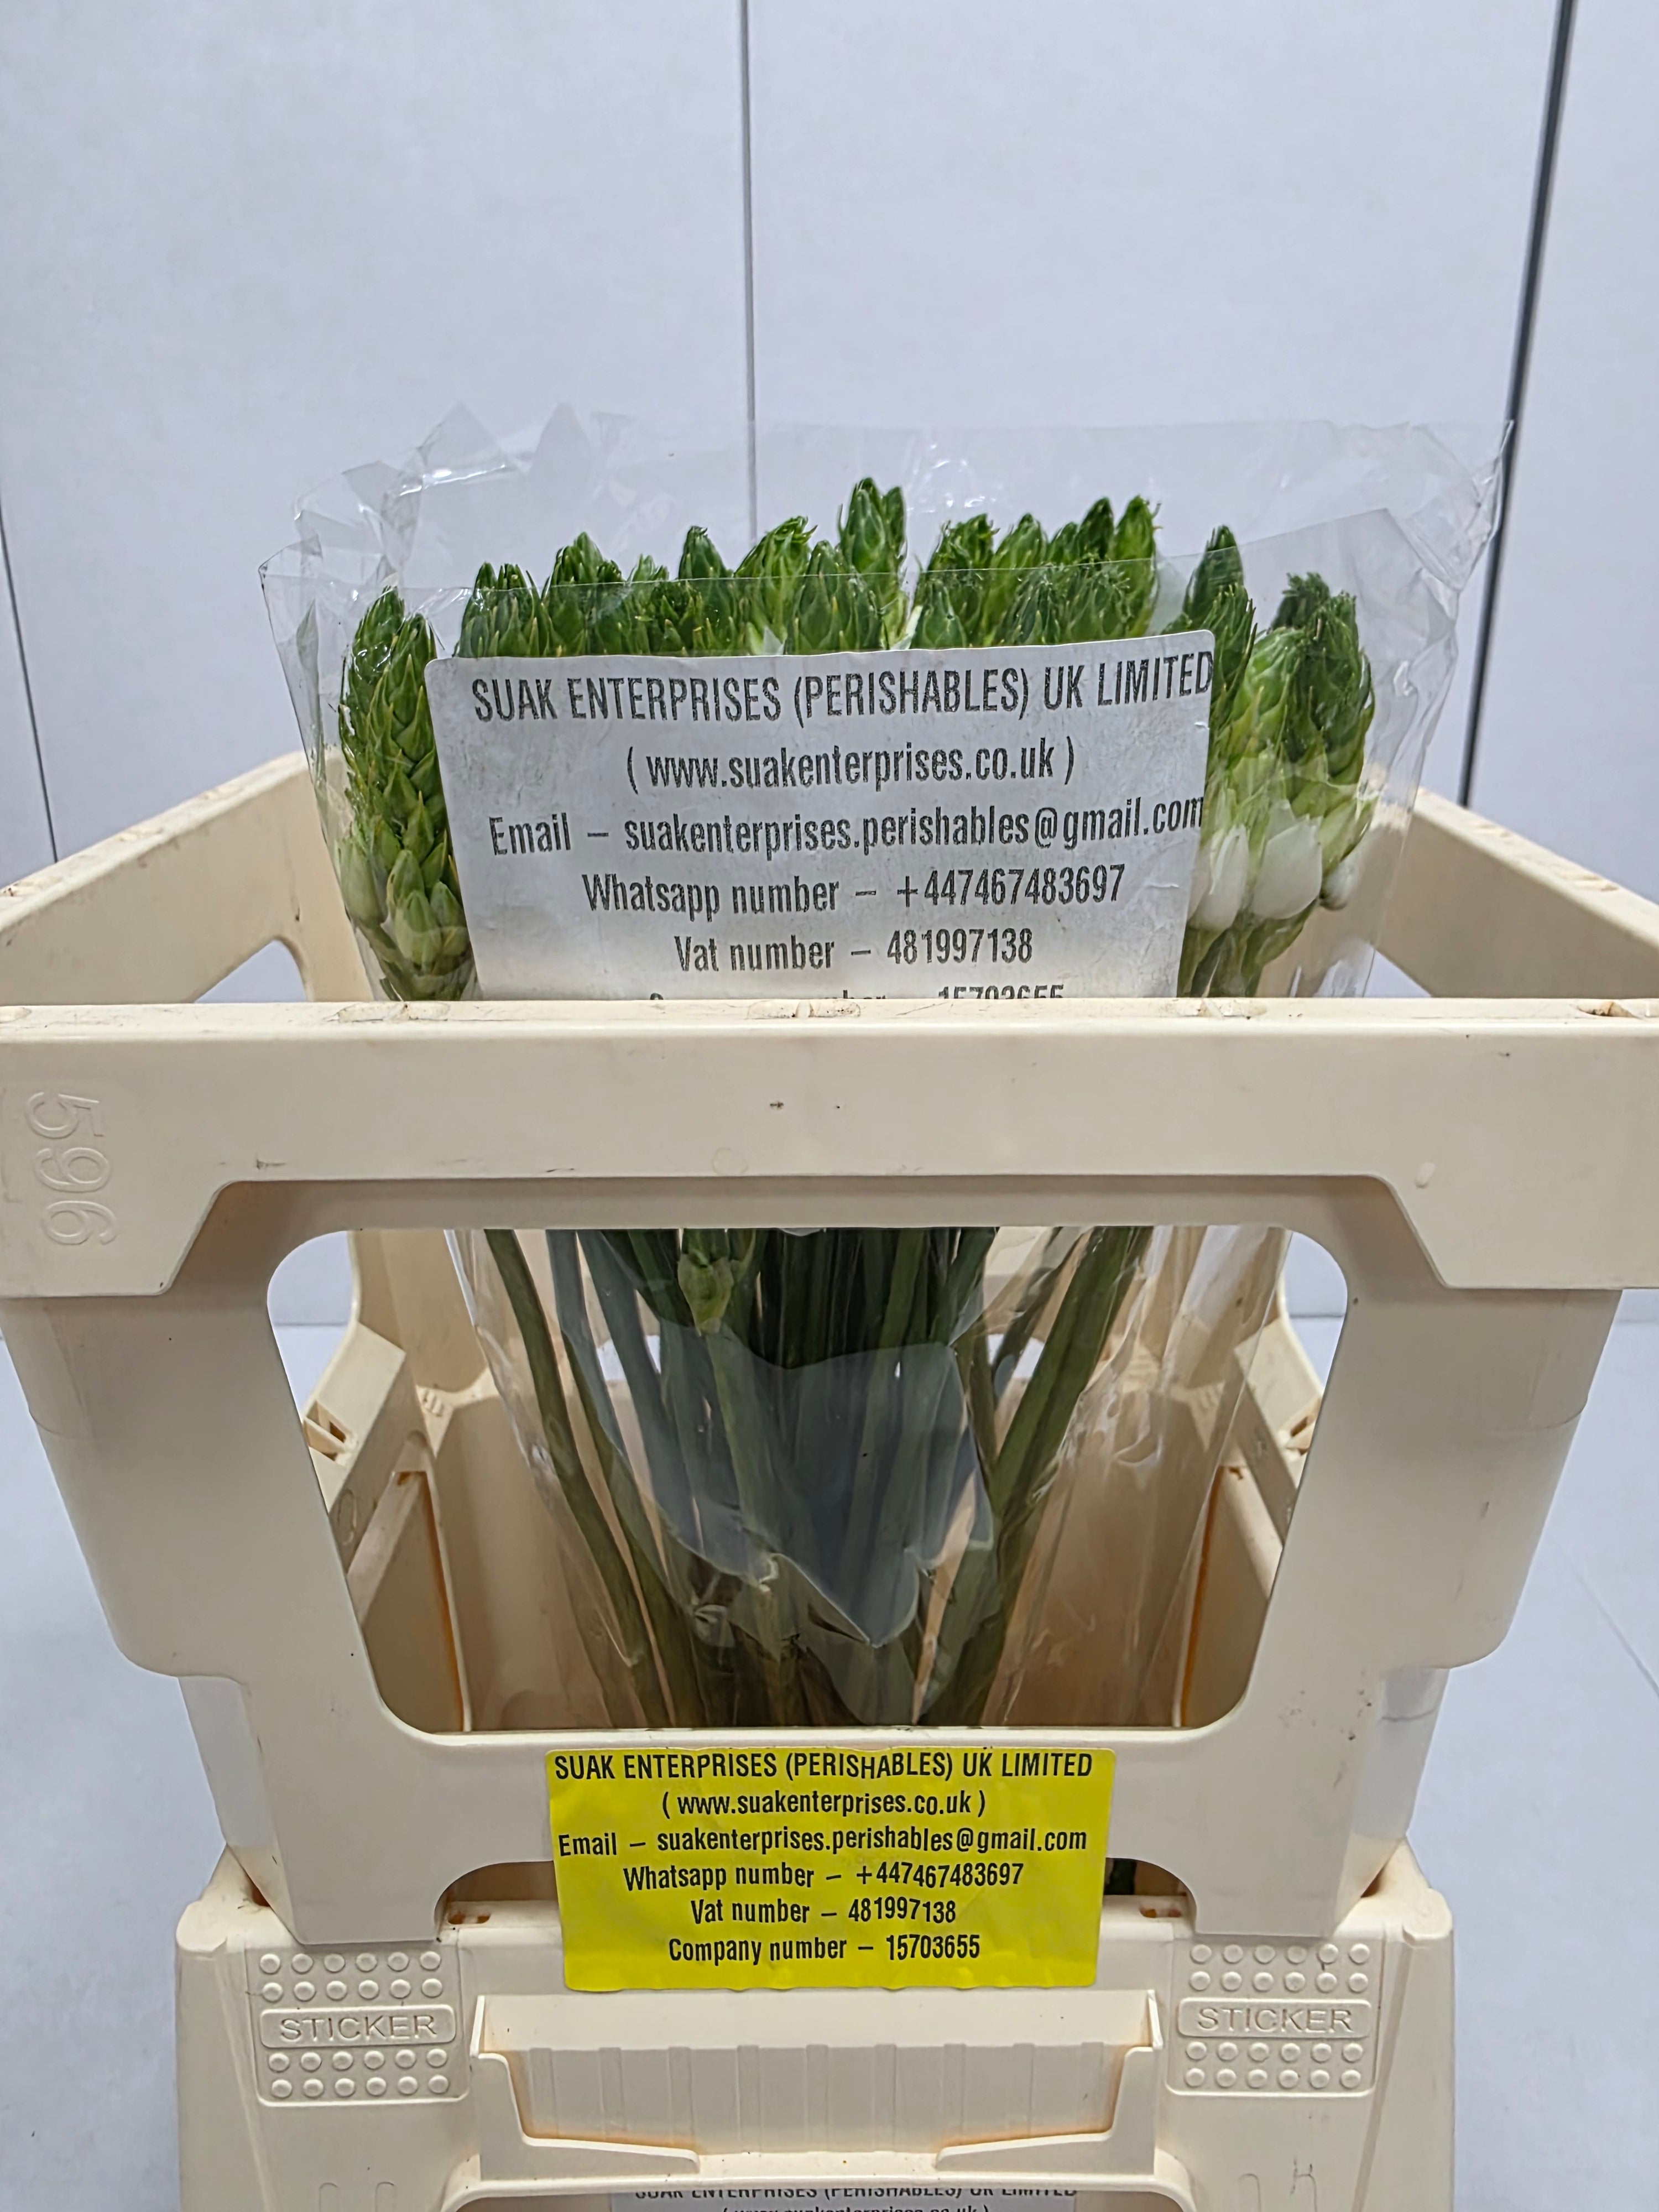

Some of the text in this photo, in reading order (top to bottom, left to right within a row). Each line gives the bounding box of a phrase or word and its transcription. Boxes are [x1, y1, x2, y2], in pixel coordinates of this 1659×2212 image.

[472, 651, 1213, 728] SUAK ENTERPRISES (PERISHABLES) UK LIMITED
[646, 737, 1055, 792] www.suakenterprises.co.uk
[489, 812, 571, 855] Email
[582, 873, 721, 922] Whatsapp
[732, 876, 840, 915] number
[896, 864, 1125, 909] +447467483697
[674, 935, 719, 972] Vat
[730, 934, 835, 971] number
[886, 928, 1032, 965] 481997138
[25, 1091, 117, 1245] 596
[555, 1751, 1092, 1782] SUAK ENTERPRISES (PERISHABLES) UK LIMITED
[677, 1790, 972, 1816] www.suakenterprises.co.uk
[559, 1832, 617, 1857] Email
[657, 1825, 1087, 1855] suakenterprises.perishables@gmail.com
[623, 1865, 727, 1892] Whatsapp
[735, 1863, 814, 1887] number
[857, 1861, 1024, 1888] +447467483697
[691, 1900, 724, 1924] Vat
[732, 1898, 810, 1923] number
[849, 1896, 956, 1924] 481997138
[669, 1938, 762, 1966] Company
[769, 1936, 847, 1960] number
[886, 1933, 980, 1961] 15703655
[280, 2014, 437, 2041] STICKER
[1197, 2007, 1353, 2032] STICKER
